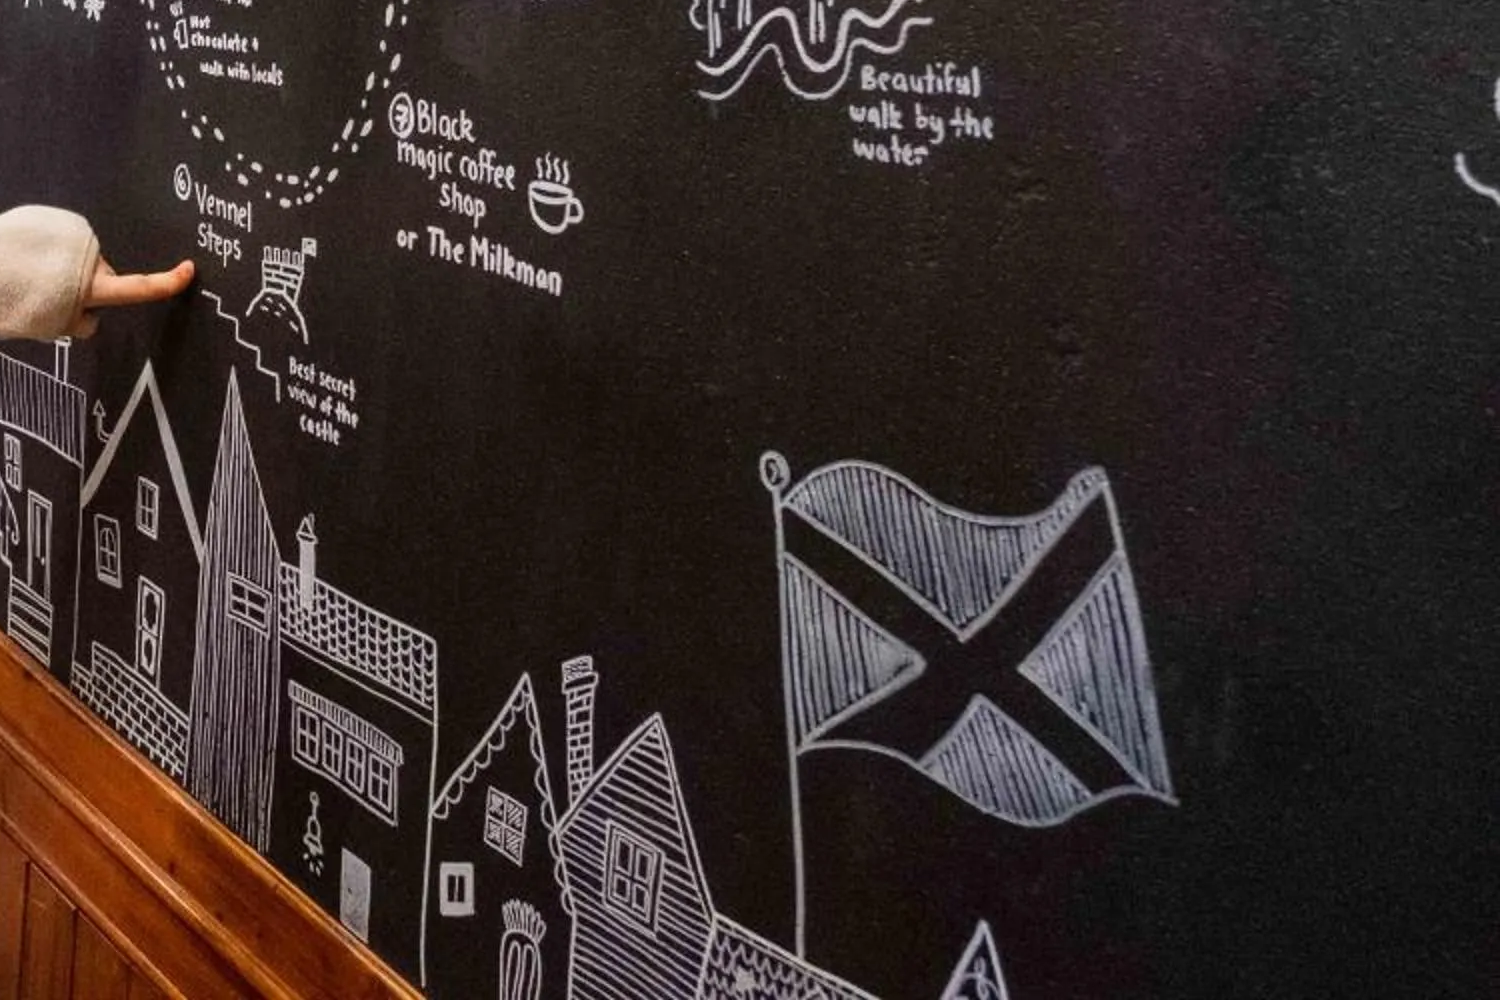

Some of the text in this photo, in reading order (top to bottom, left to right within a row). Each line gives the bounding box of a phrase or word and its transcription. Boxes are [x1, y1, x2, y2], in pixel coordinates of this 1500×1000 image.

[861, 62, 981, 98] Beautiful
[417, 98, 477, 143] Black
[850, 100, 994, 144] walk by the
[459, 148, 516, 191] coffee
[194, 182, 252, 232] Vennel
[198, 223, 242, 268] Steps
[397, 225, 562, 297] or The Milkman
[300, 414, 340, 446] castle
